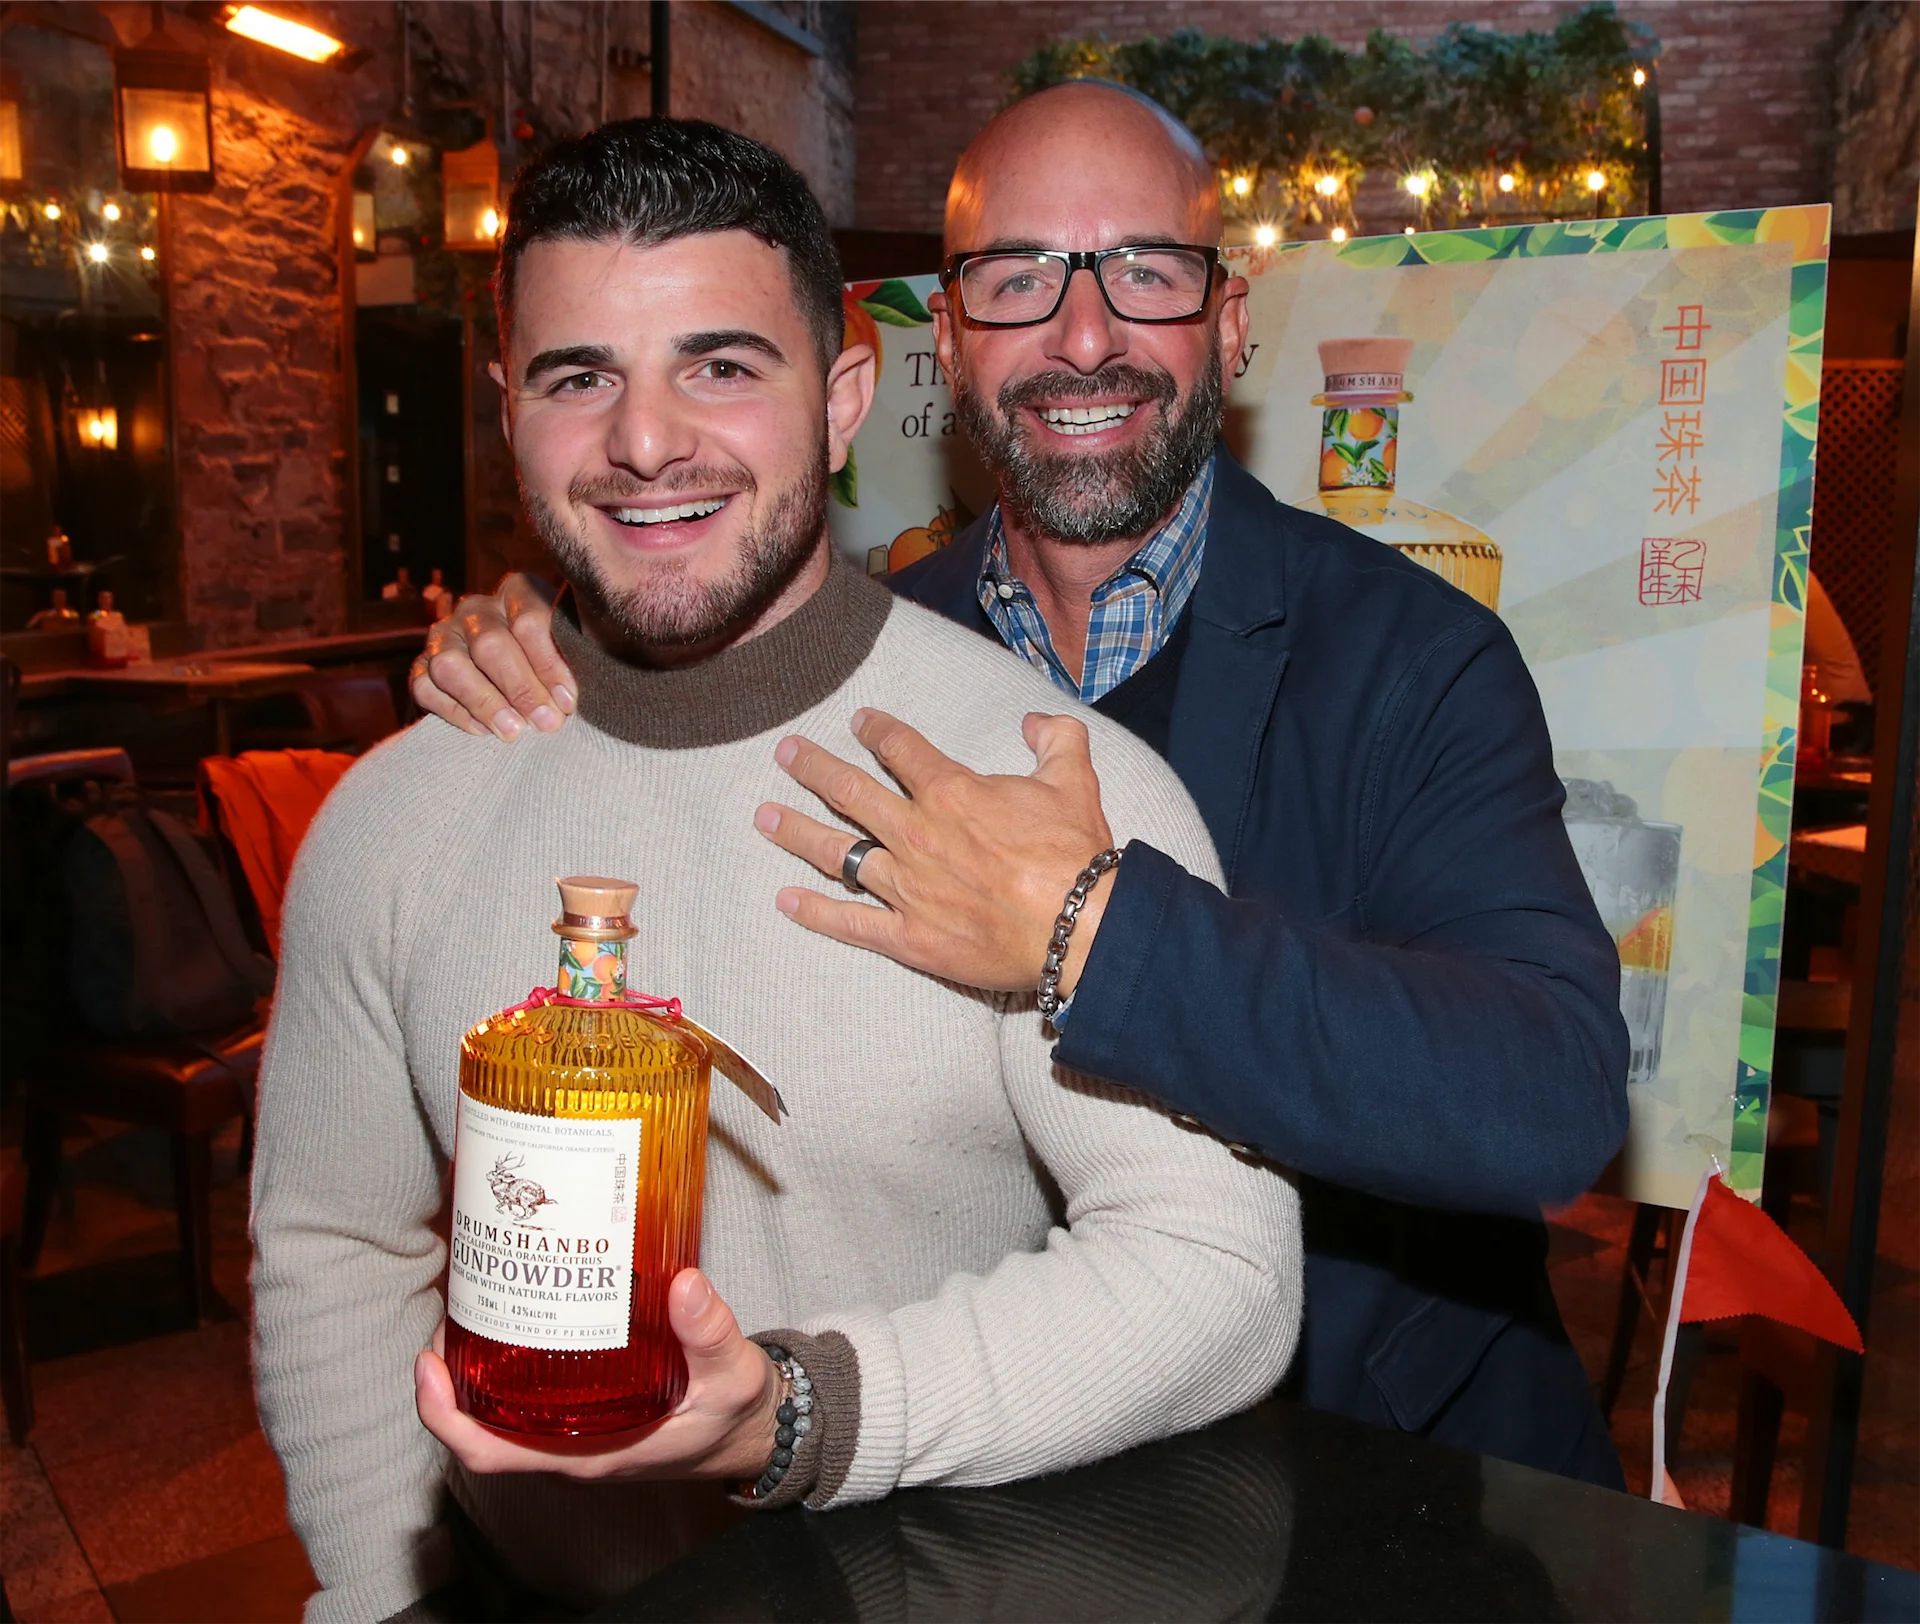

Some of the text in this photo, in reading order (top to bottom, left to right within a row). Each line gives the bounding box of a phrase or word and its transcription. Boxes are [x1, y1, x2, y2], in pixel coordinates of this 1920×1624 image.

[901, 401, 934, 438] of
[489, 1115, 509, 1127] WITH
[510, 1121, 552, 1134] ORIENTAL
[527, 1142, 563, 1152] CALIFORNIA
[456, 1209, 609, 1254] DRUMSHANBO
[466, 1235, 513, 1258] CALIFORNIA
[515, 1250, 559, 1264] ORANGE
[562, 1255, 602, 1265] CITRUS
[465, 1271, 478, 1285] GIN
[480, 1277, 506, 1293] WITH
[508, 1286, 562, 1302] NATURAL
[565, 1291, 619, 1302] FLAVORS
[477, 1294, 498, 1311] 750ML
[461, 1305, 473, 1317] THE
[474, 1313, 510, 1329] CURIOUS
[515, 1324, 540, 1334] MIND
[545, 1328, 558, 1336] OF
[563, 1329, 574, 1338] PJ
[579, 1327, 618, 1337] RIGNEY
